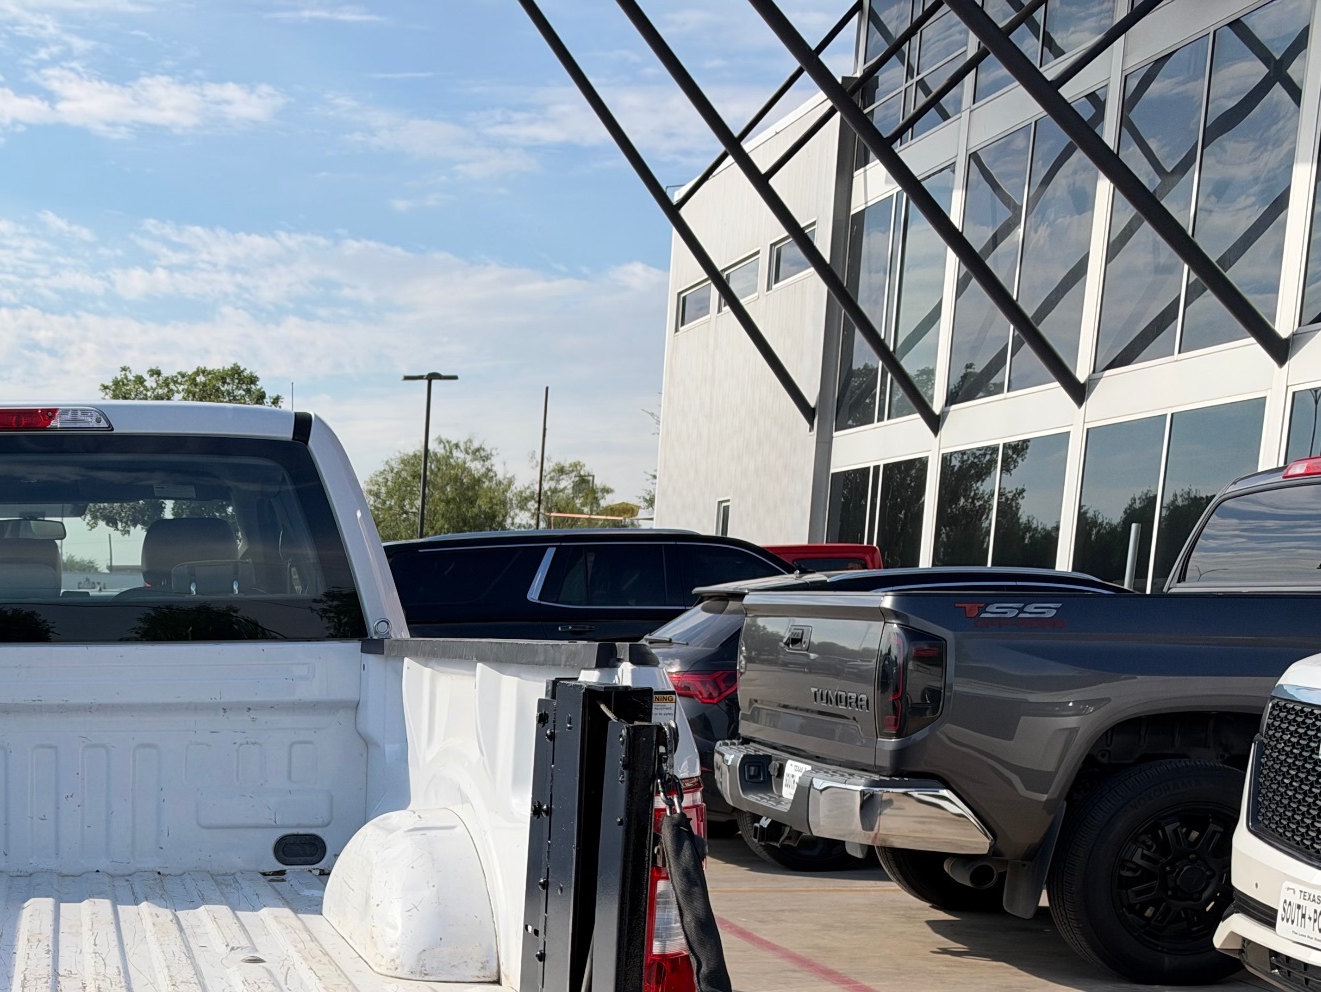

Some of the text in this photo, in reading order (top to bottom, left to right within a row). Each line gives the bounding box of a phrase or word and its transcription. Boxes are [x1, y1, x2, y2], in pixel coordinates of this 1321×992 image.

[954, 602, 1063, 618] TSS
[811, 687, 870, 712] TUNDRA
[1299, 890, 1321, 905] TEXAS
